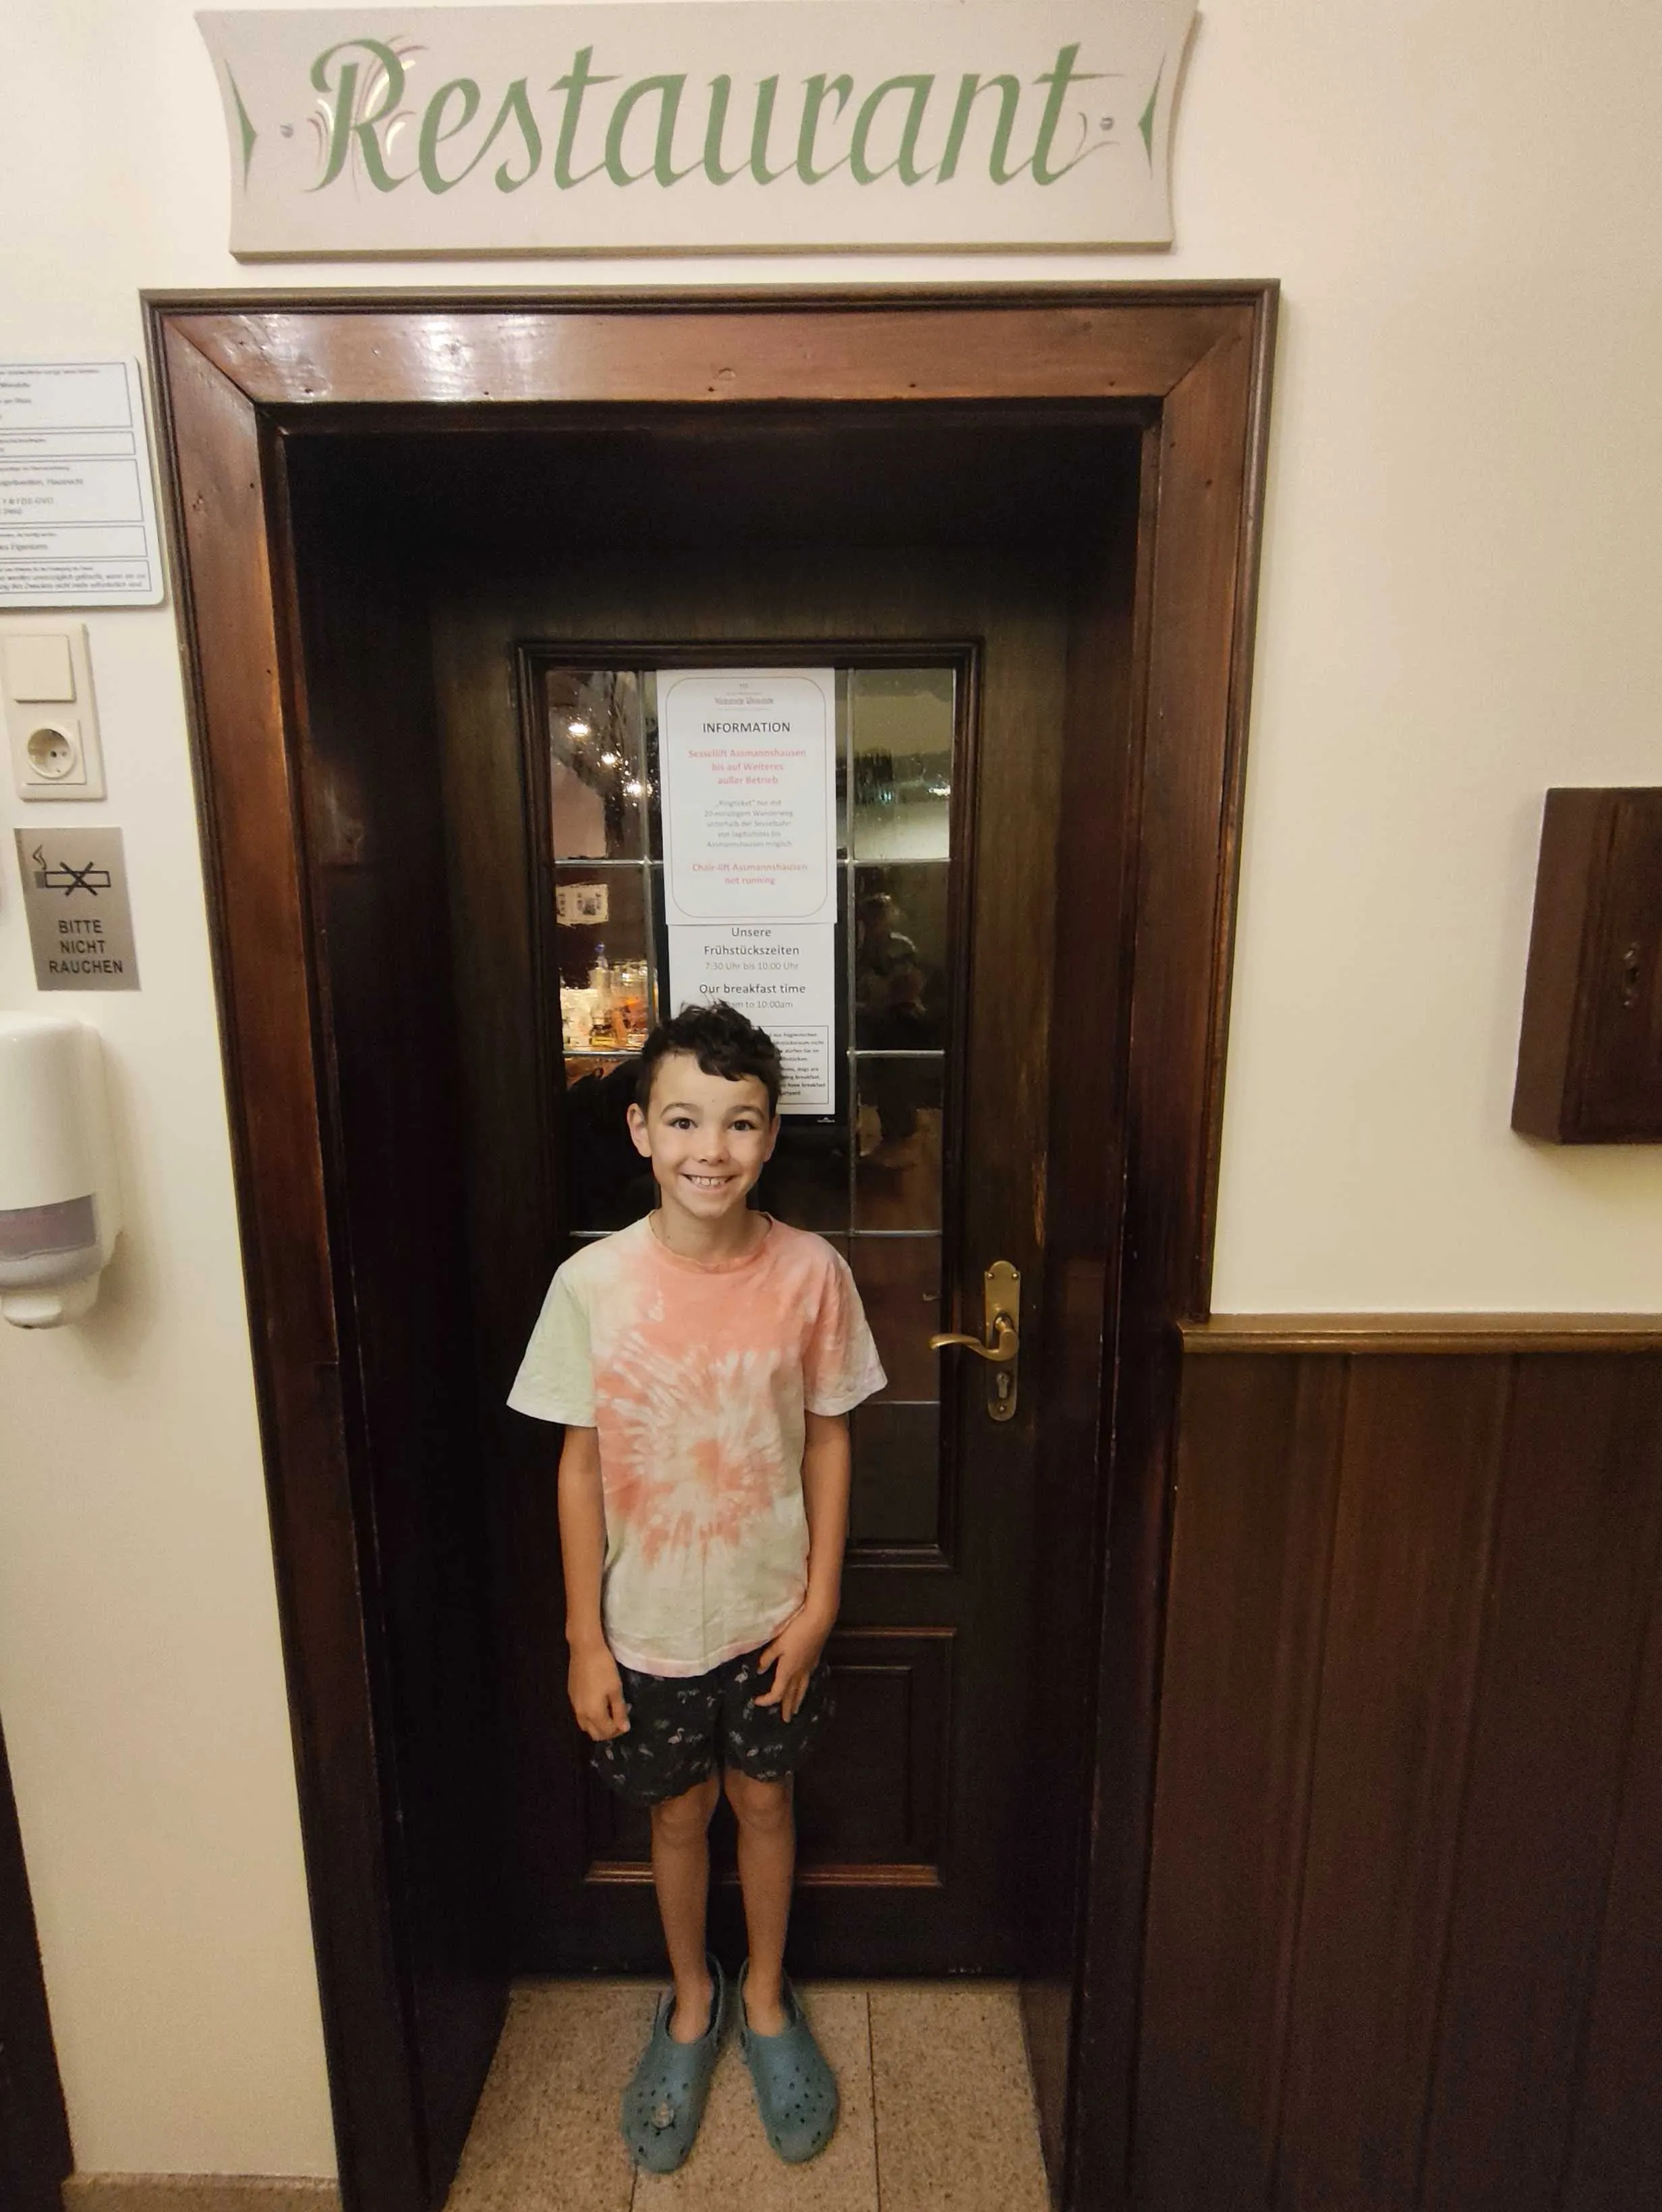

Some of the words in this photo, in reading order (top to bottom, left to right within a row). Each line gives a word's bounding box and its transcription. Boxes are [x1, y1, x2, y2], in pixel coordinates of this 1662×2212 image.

[307, 38, 1123, 196] Restaurant
[703, 723, 791, 733] INFORMATION
[688, 749, 727, 758] Sessellift
[730, 749, 806, 757] Assmannshausen
[712, 763, 725, 771] bis
[727, 763, 741, 771] auf
[744, 763, 784, 771] Weiteres
[717, 776, 743, 784] außer
[745, 776, 778, 784] Betrieb
[692, 863, 730, 871] Chair-lift
[733, 863, 808, 871] Assmannshausen
[743, 877, 776, 885] running
[59, 920, 103, 933] BITTE
[731, 927, 772, 937] Unsere
[60, 941, 106, 954] NICHT
[704, 944, 800, 956] Frühstückszeiten
[49, 960, 124, 974] RAUCHEN
[726, 962, 741, 970] Uhr
[743, 962, 755, 970] bis
[783, 961, 799, 970] Uhr
[699, 984, 720, 994] Our
[723, 983, 777, 993] breakfast
[780, 983, 806, 993] time
